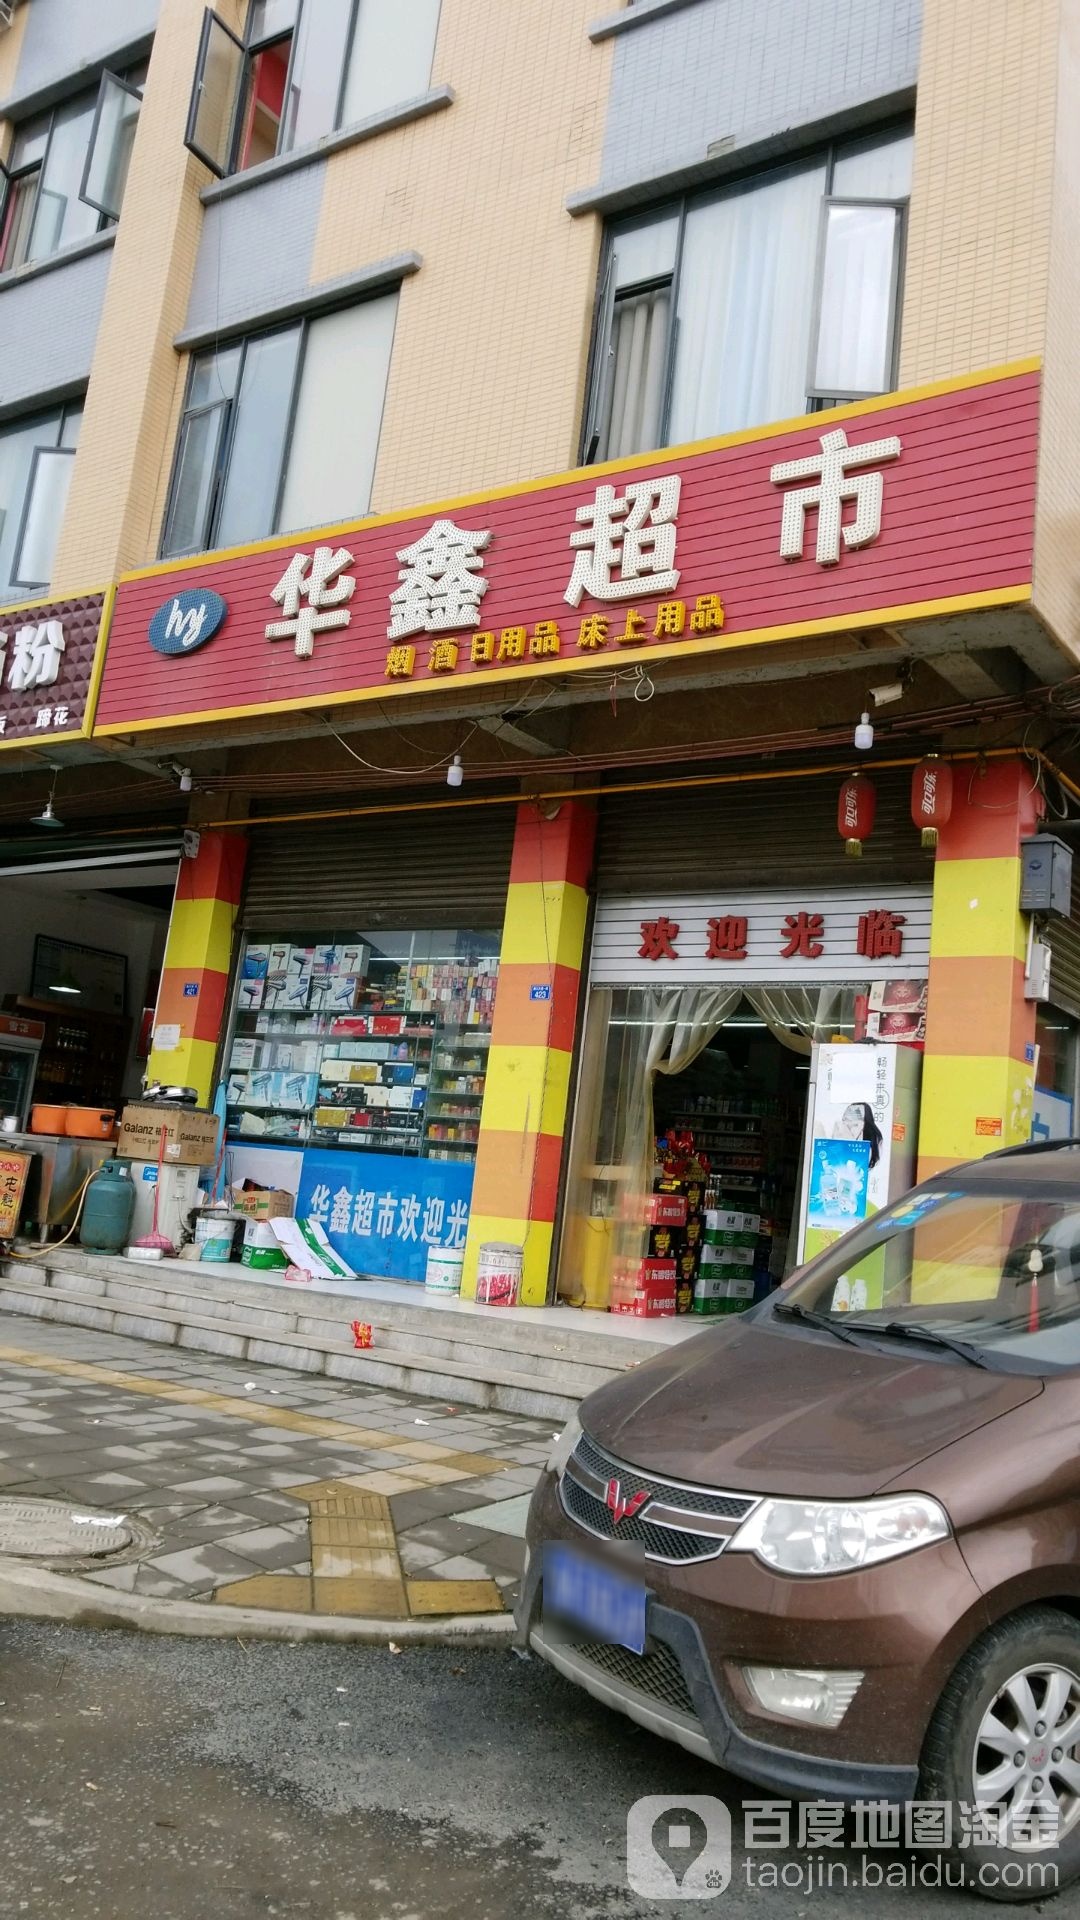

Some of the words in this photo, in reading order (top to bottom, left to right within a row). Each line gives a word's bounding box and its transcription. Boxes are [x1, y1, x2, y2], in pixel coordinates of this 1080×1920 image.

[264, 427, 902, 658] 华鑫超市
[921, 769, 938, 815] 可口可乐
[637, 909, 907, 961] 欢迎光临
[124, 1122, 154, 1135] Galanz
[308, 1184, 469, 1248] 华鑫超市欢迎光
